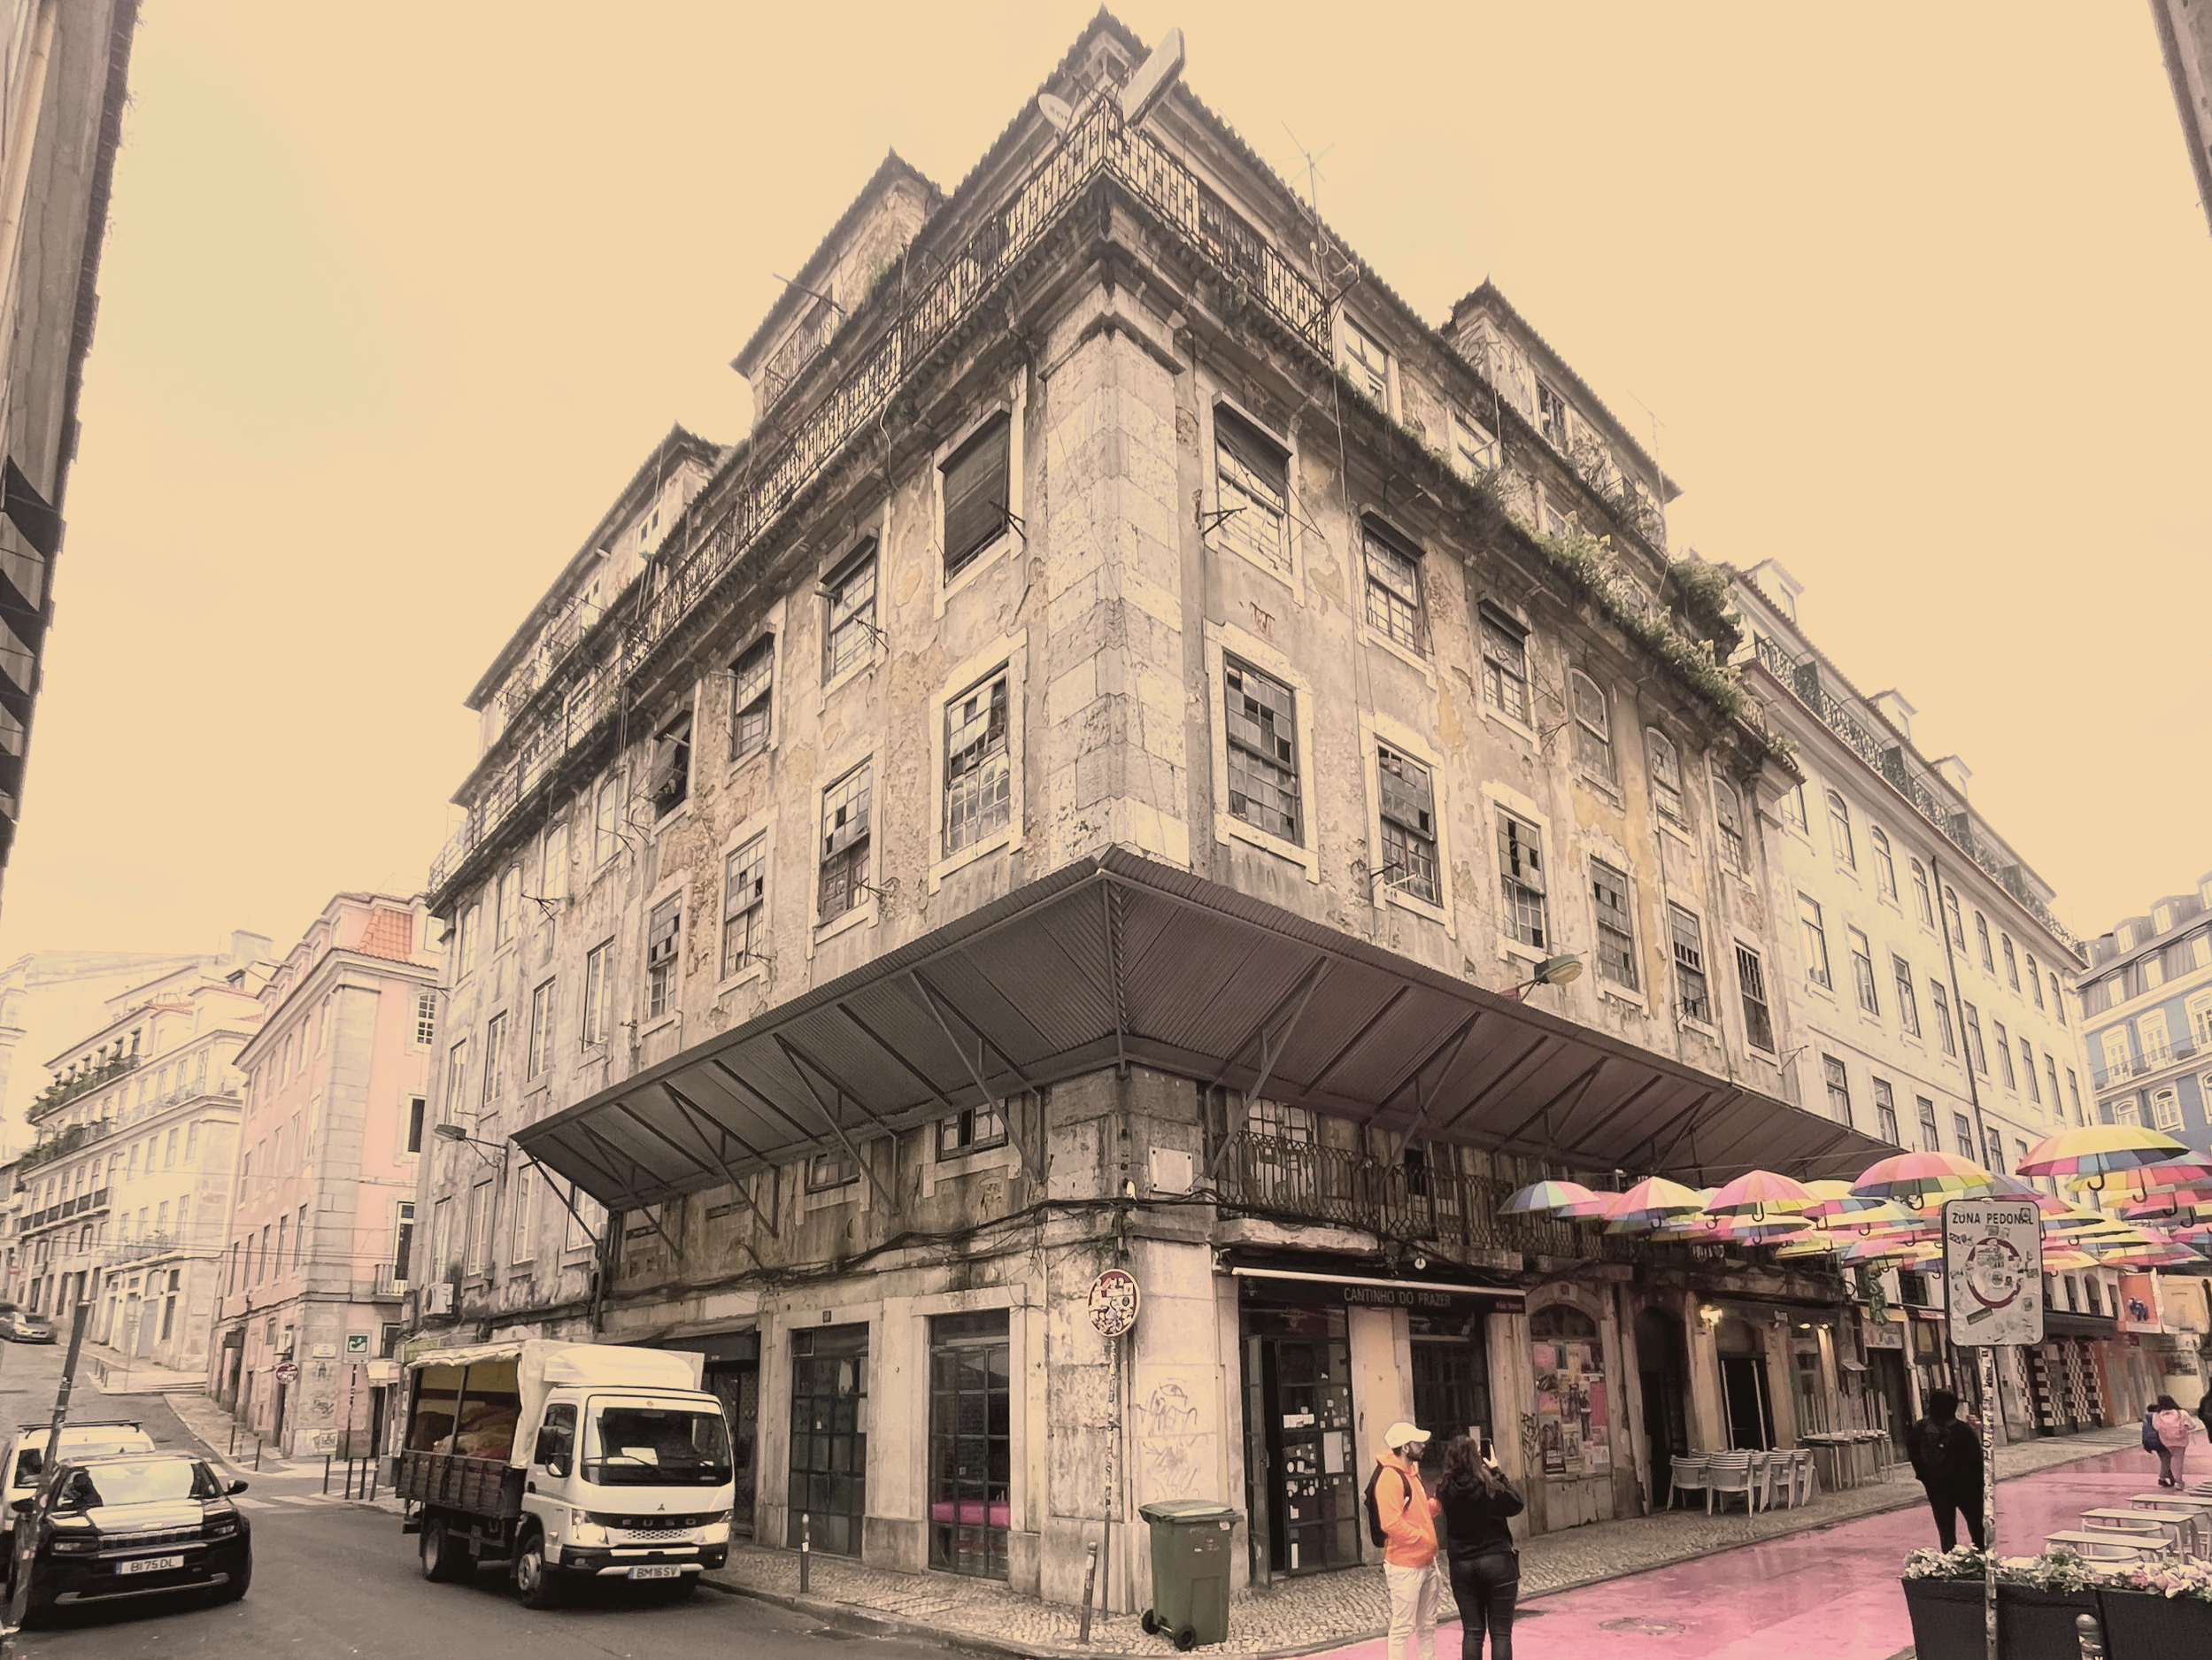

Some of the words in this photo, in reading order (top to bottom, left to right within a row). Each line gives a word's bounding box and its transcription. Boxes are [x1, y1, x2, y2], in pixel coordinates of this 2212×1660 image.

[1952, 1212, 1981, 1224] ZONA
[1344, 1287, 1395, 1304] CANTINHO
[1399, 1291, 1414, 1304] DO
[1418, 1293, 1452, 1308] PRAZER
